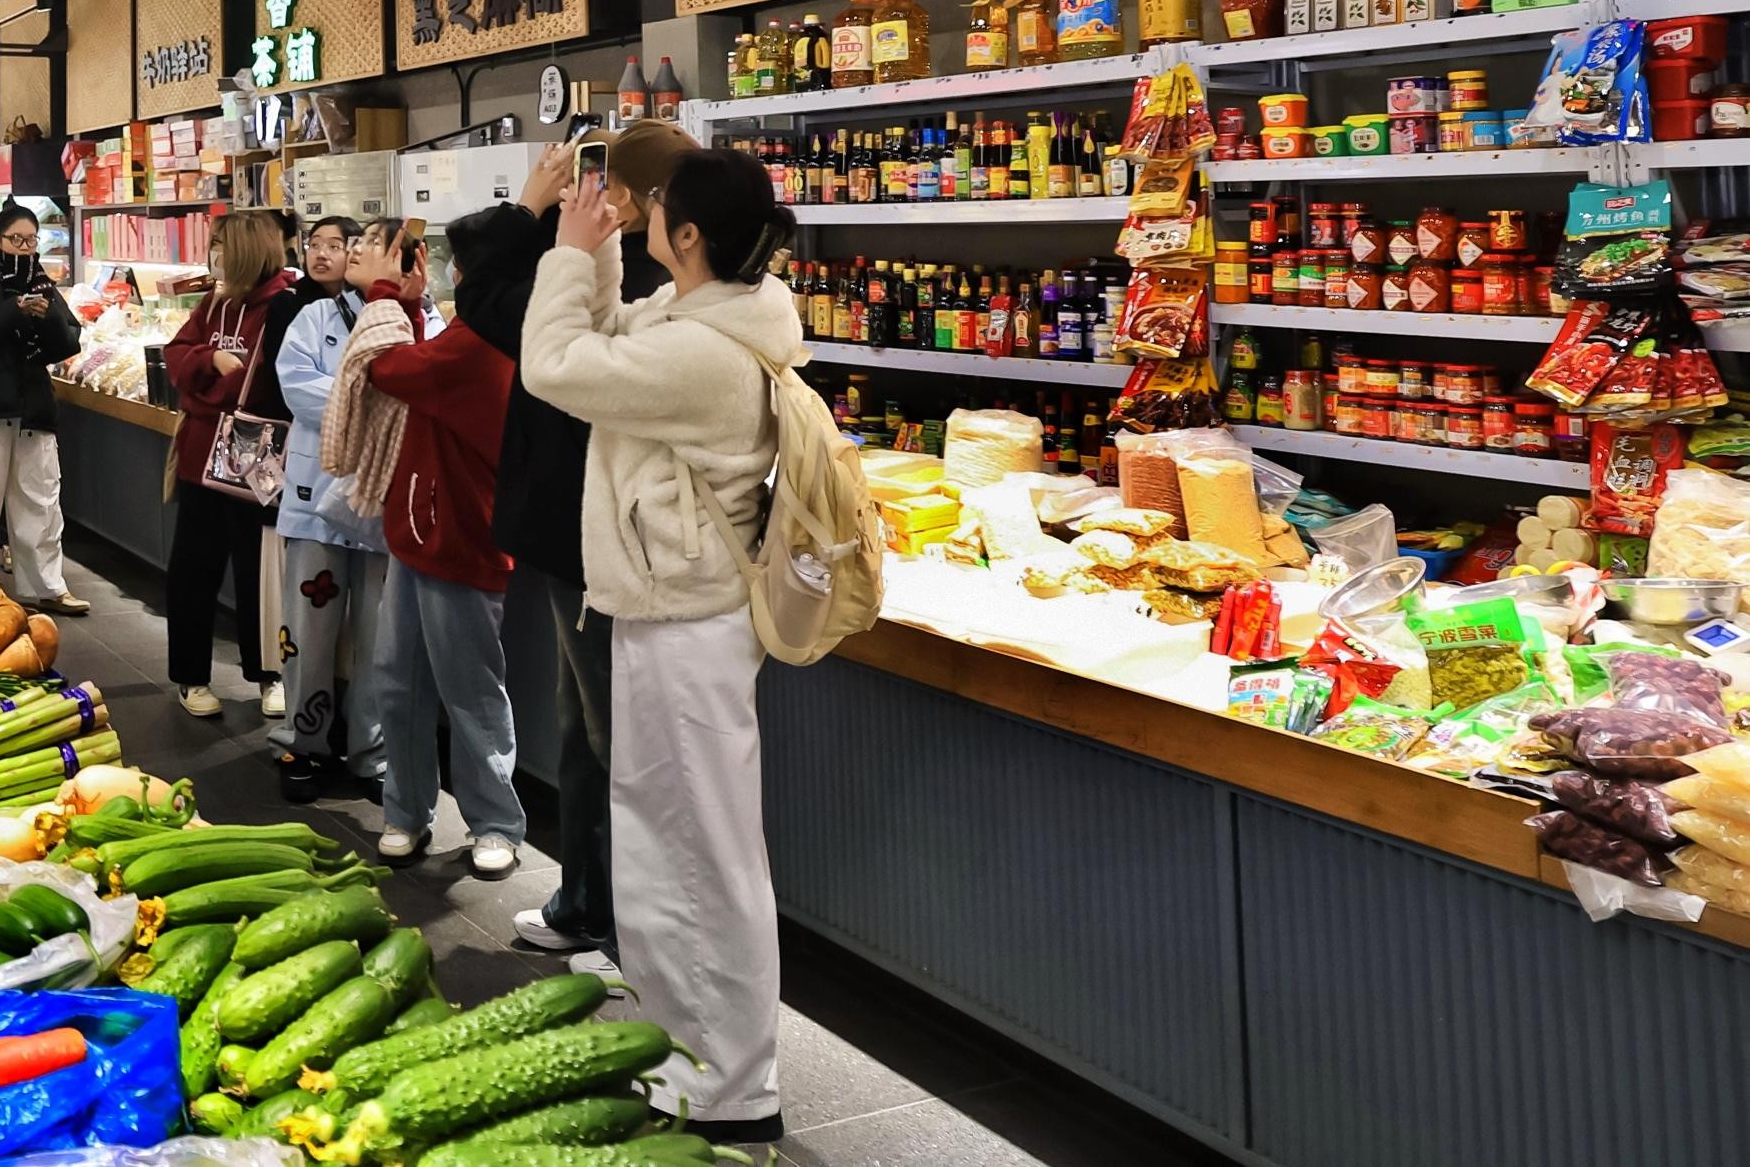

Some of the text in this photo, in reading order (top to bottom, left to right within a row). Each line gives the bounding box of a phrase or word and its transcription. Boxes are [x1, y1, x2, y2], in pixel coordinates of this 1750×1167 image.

[142, 33, 210, 89] 牛奶驿站
[252, 28, 316, 88] 茶铺
[1418, 623, 1499, 647] 宁波雪菜
